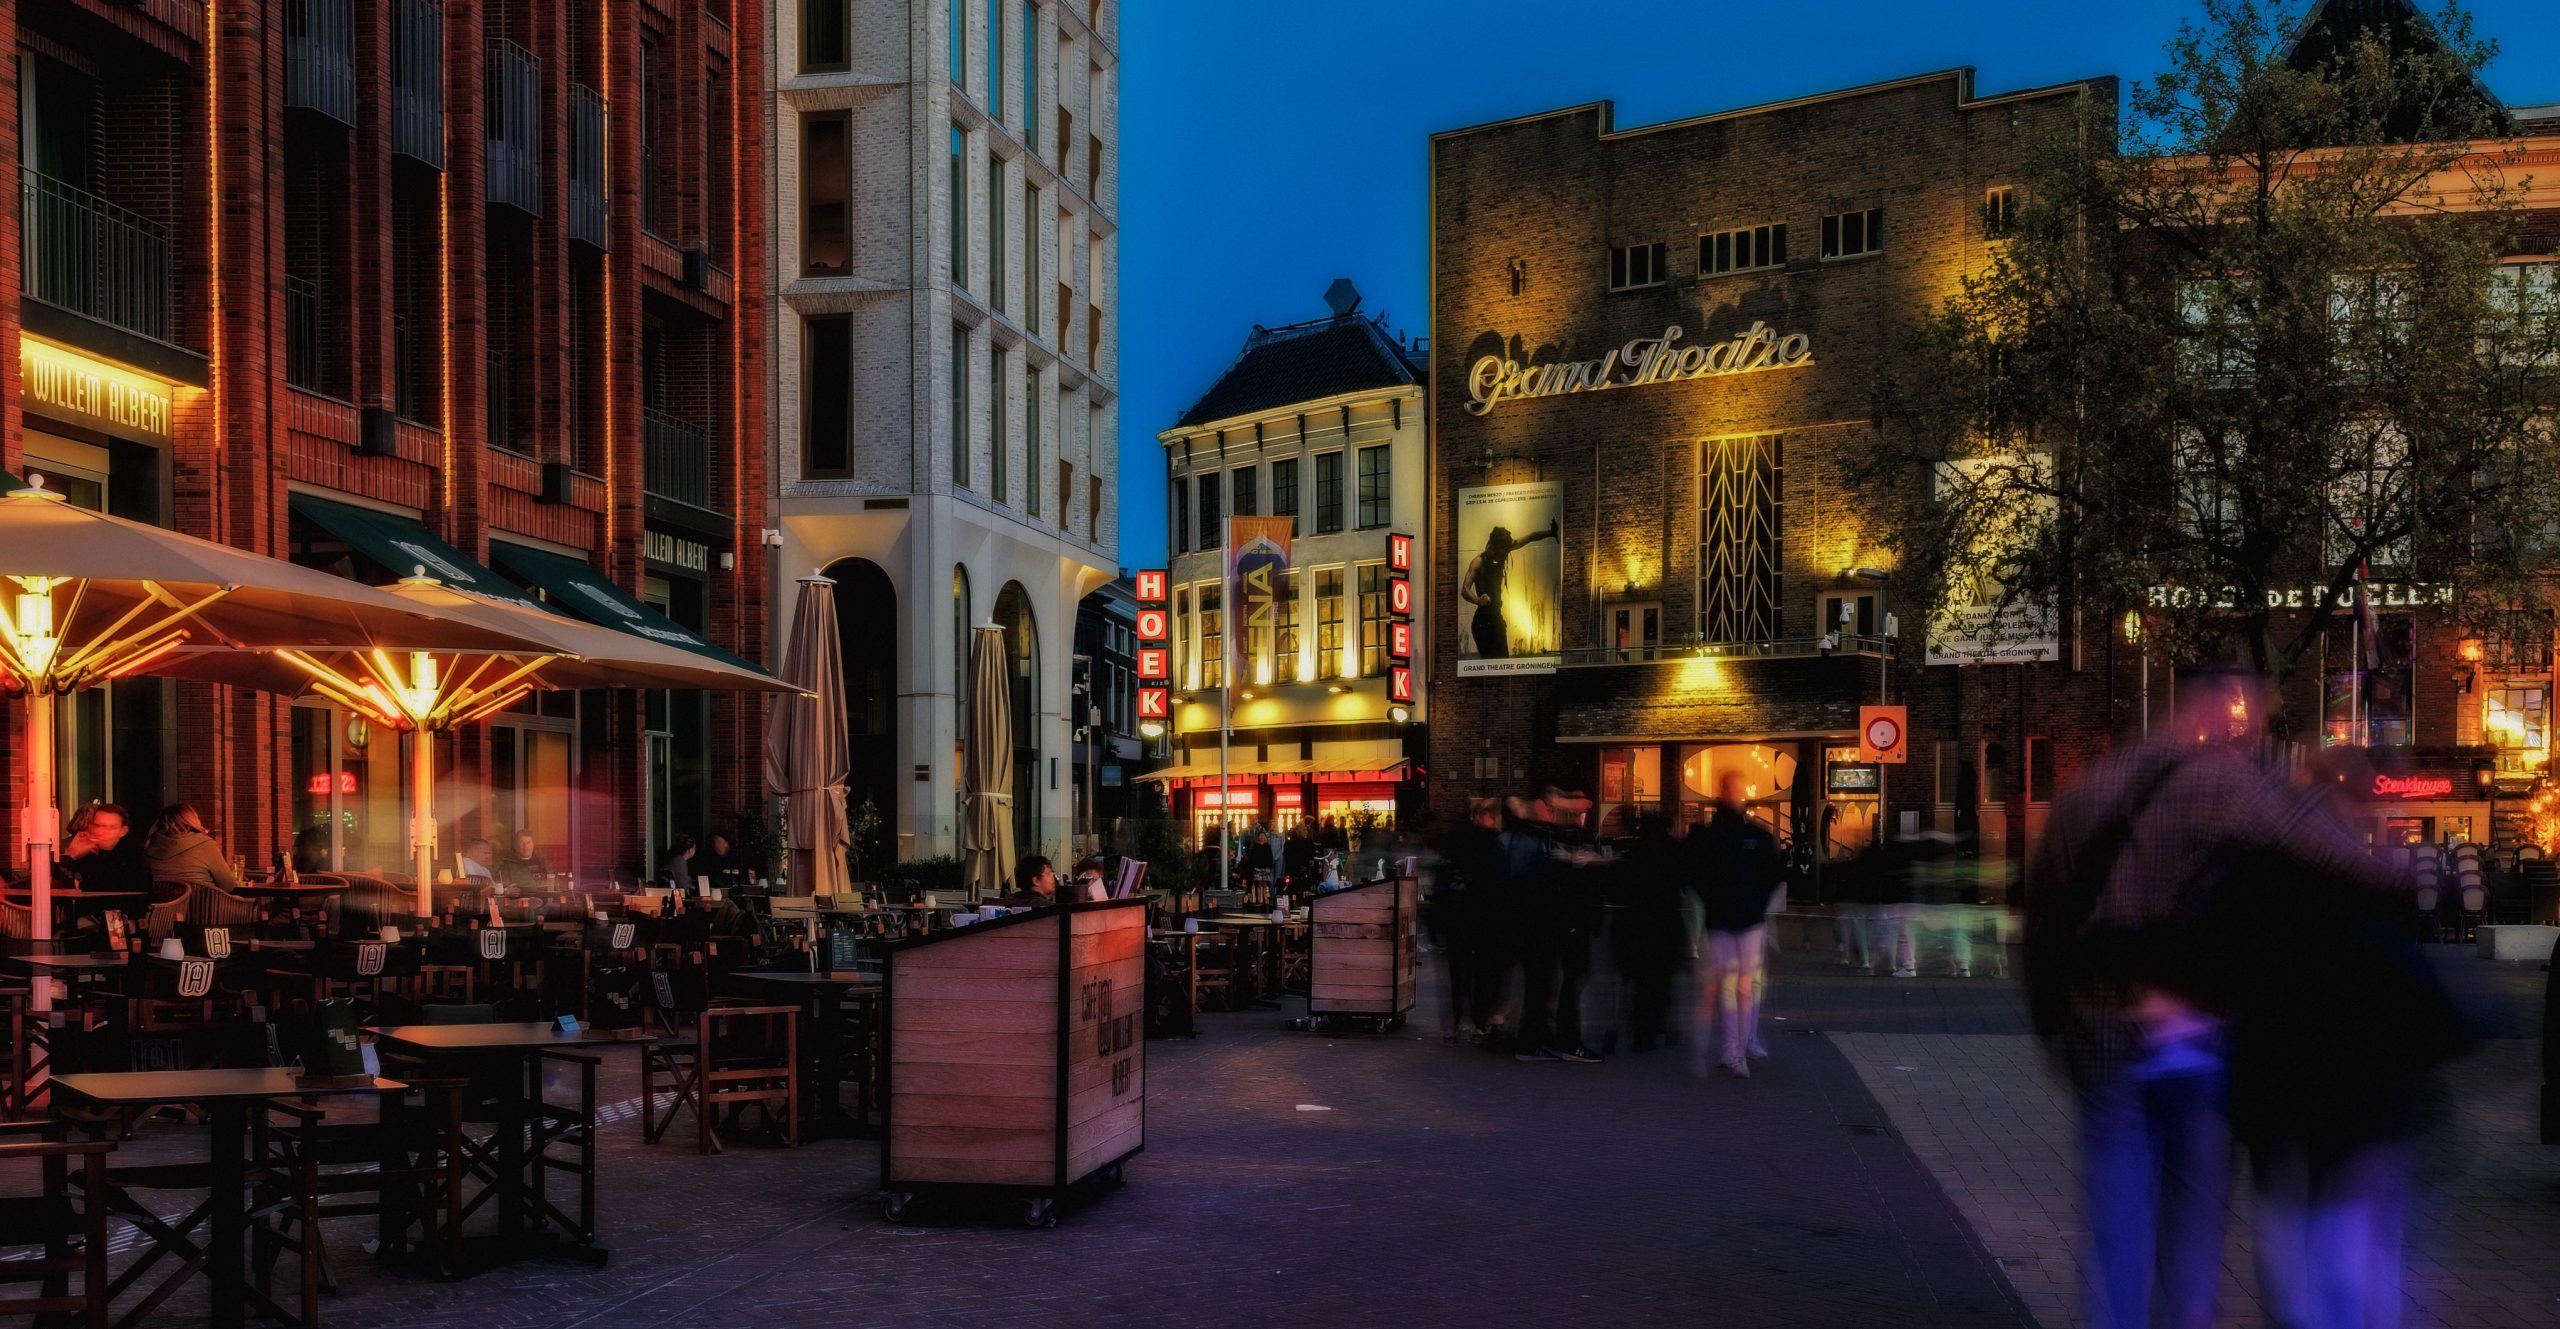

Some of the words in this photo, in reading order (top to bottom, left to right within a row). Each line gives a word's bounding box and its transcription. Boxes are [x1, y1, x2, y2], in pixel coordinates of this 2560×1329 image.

[1464, 348, 1618, 416] Grand
[1620, 320, 1811, 385] Theatre
[33, 357, 101, 417] WILLEM
[108, 379, 169, 436] ALBERT
[676, 538, 708, 572] ALBERT
[1140, 574, 1163, 715] HOEK
[1393, 540, 1408, 697] HOEK
[1463, 664, 1486, 672] GRAND
[1487, 663, 1515, 671] THEATRE
[1932, 651, 1960, 660] GRAND
[1963, 650, 1997, 659] THEATRE
[2372, 774, 2452, 798] Steakhouse
